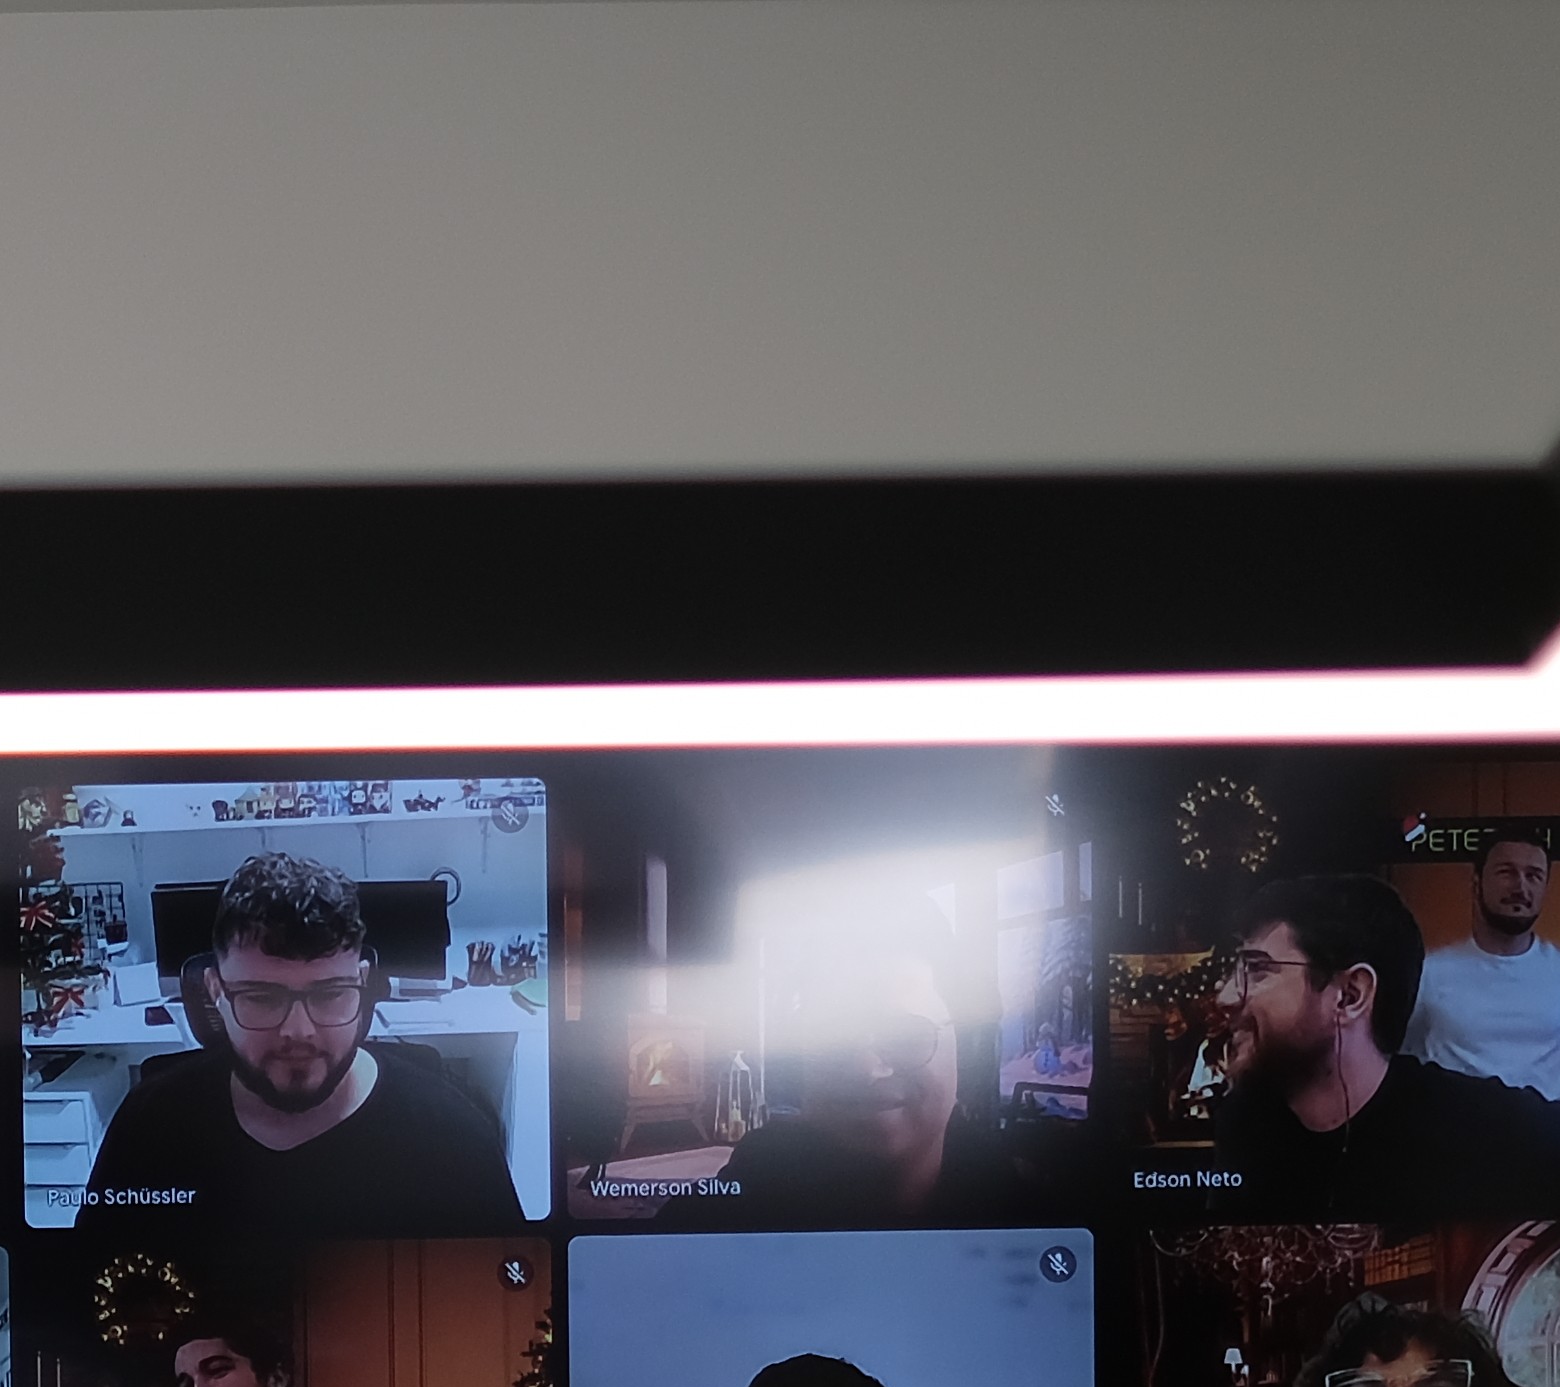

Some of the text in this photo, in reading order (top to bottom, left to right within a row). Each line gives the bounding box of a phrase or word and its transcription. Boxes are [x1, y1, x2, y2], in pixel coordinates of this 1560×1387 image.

[590, 1179, 741, 1197] Wemerson Silva
[1134, 1171, 1242, 1188] Edson Neto
[47, 1187, 196, 1207] Paulo Schüssler
